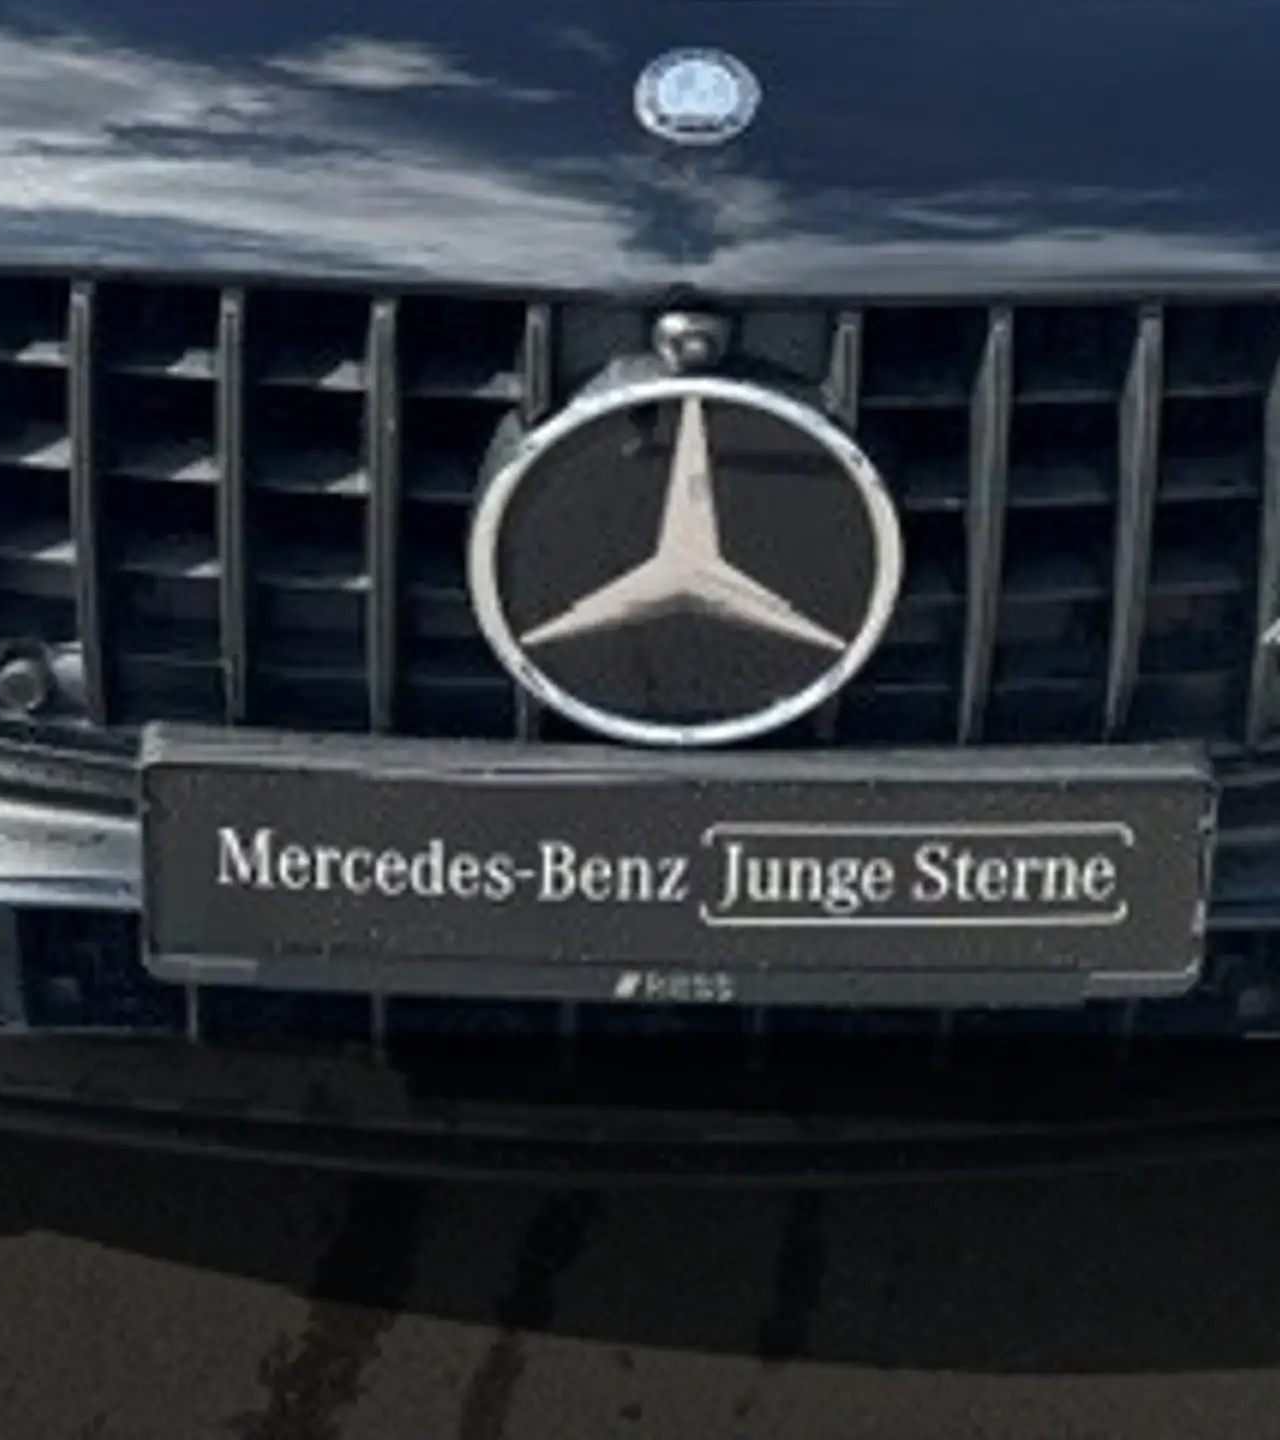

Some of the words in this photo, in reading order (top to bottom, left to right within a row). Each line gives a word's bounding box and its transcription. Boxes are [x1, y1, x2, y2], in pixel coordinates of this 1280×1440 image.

[215, 827, 690, 902] Mercedes-Benz
[720, 843, 894, 915] Junge
[912, 845, 1118, 904] Sterne
